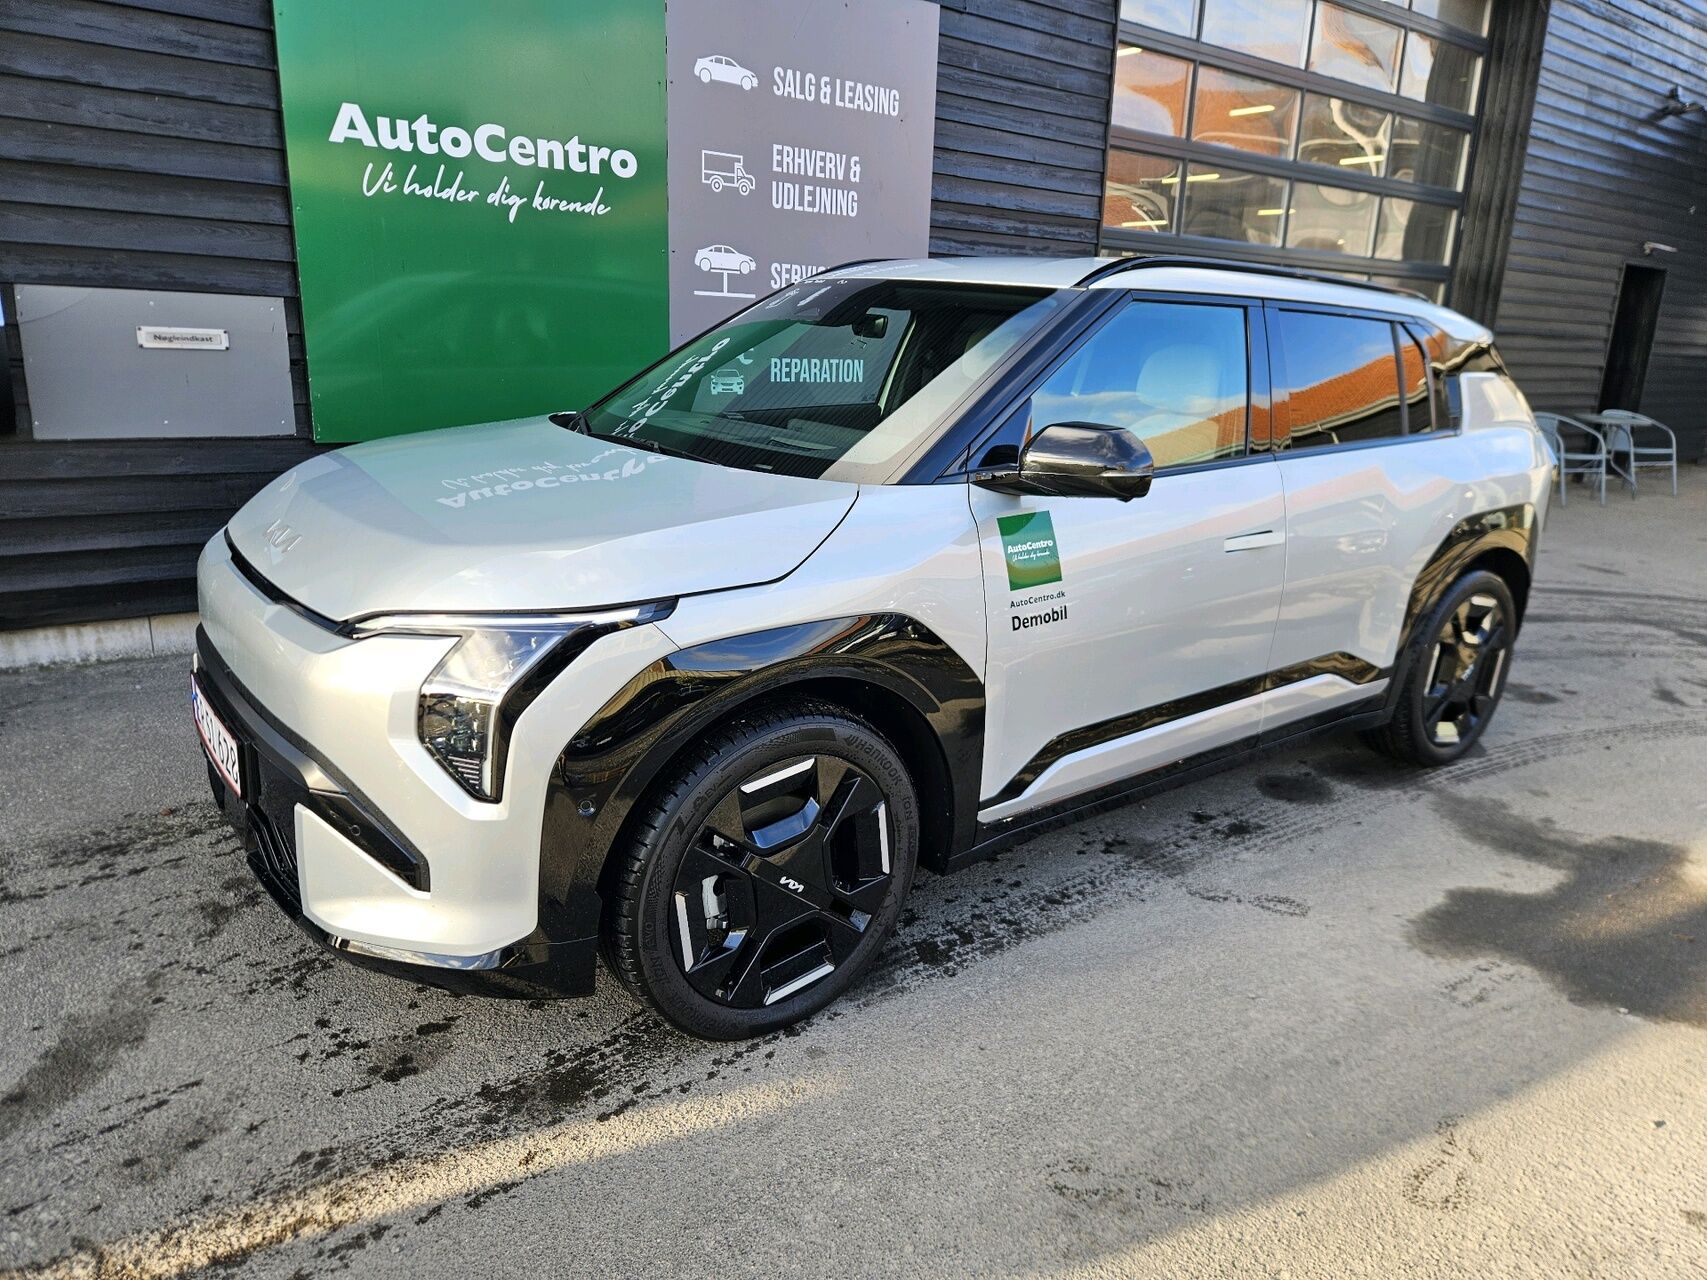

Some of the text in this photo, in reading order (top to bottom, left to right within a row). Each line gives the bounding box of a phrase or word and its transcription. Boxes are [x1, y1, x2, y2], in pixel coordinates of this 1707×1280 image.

[773, 66, 900, 117] SALG & LEASING
[328, 102, 638, 179] AutoCentro
[772, 144, 861, 183] ERHVERV &
[362, 162, 398, 197] Vi
[403, 163, 480, 203] holder
[487, 175, 528, 223] dig
[771, 181, 858, 217] UDLEJNING
[770, 357, 864, 383] REPARATION
[1007, 539, 1054, 554] AutoCentro
[1010, 590, 1066, 609] AutoCentro.dk
[1011, 605, 1068, 632] Demobil
